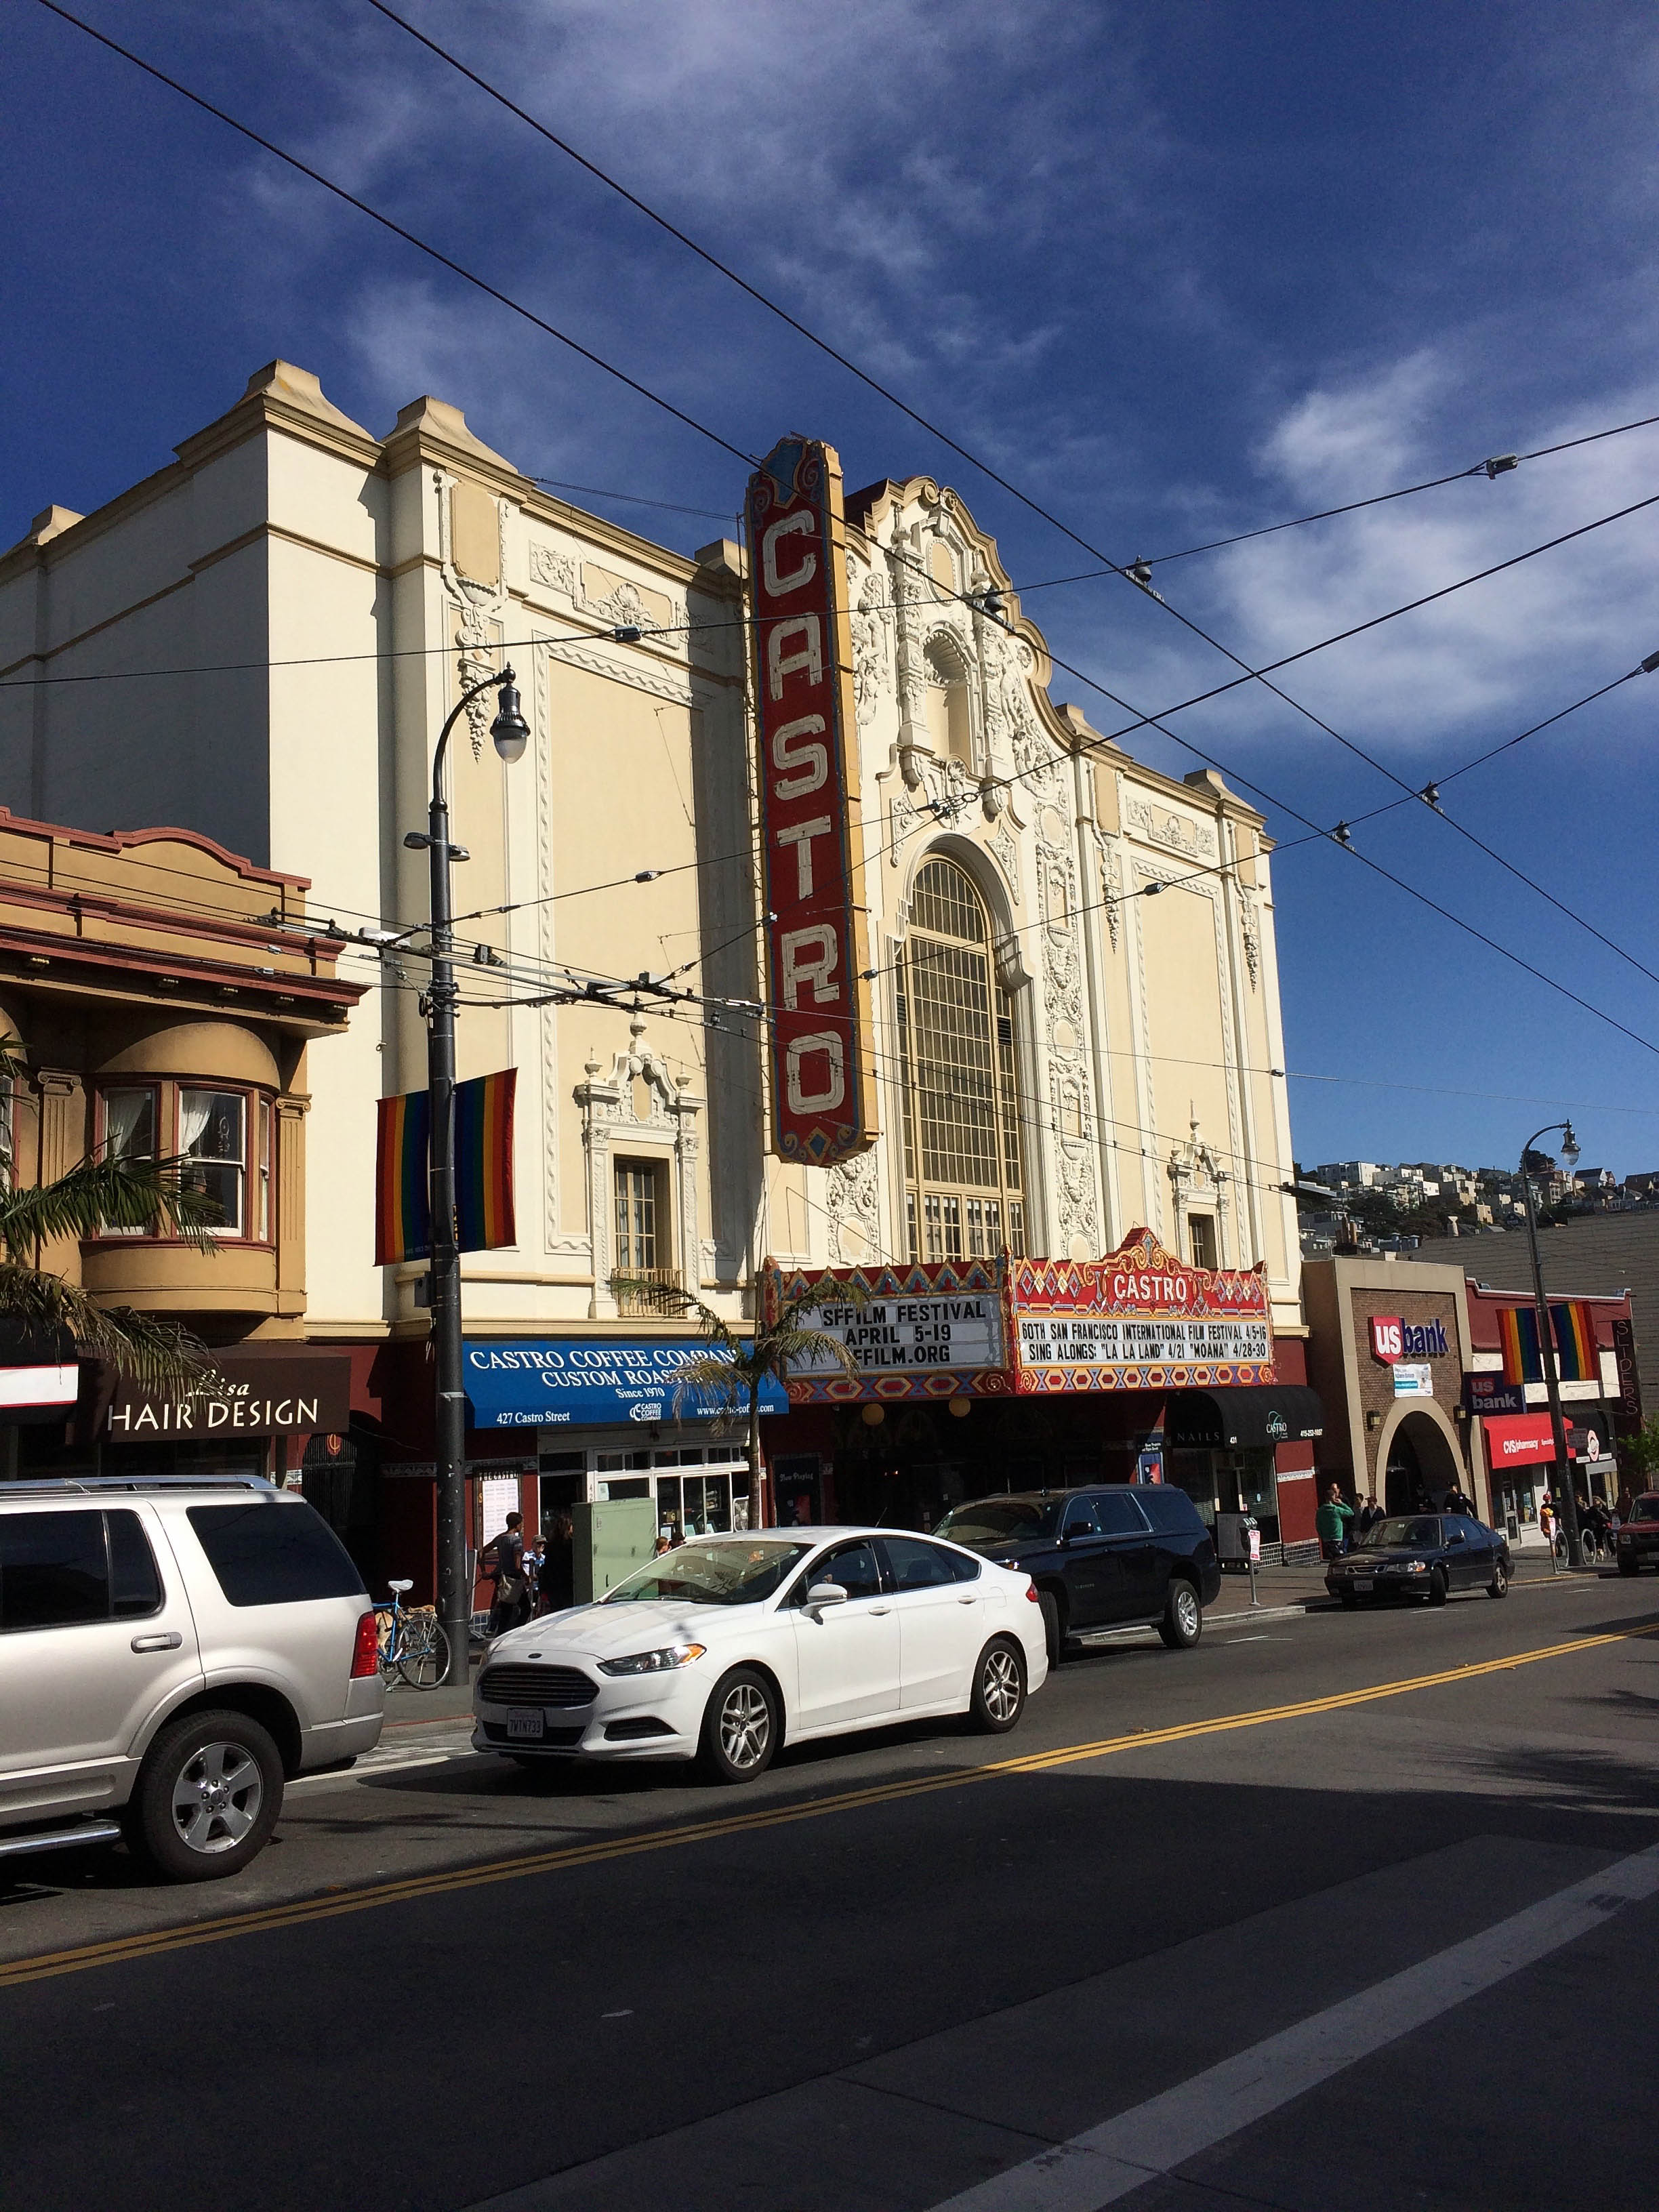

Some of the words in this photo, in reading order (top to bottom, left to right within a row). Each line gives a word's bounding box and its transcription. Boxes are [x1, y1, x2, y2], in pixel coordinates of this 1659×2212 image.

[763, 510, 844, 1115] CASTRO
[1114, 1275, 1187, 1301] CASTRO
[823, 1307, 886, 1326] SFFILM
[897, 1301, 986, 1322] FESTIVAL
[846, 1326, 900, 1345] APRIL
[915, 1324, 951, 1343] 5-19
[1022, 1323, 1046, 1340] 60TH
[1051, 1324, 1068, 1340] SAN
[1072, 1324, 1118, 1340] FRANCISCO
[1122, 1324, 1185, 1340] INTERNATIONAL
[1208, 1326, 1242, 1340] FESTIVAL
[1246, 1326, 1266, 1340] 4/5-16
[1401, 1317, 1450, 1353] bank
[470, 1351, 565, 1369] CASTRO
[569, 1350, 653, 1368] COFFEE
[653, 1349, 737, 1366] COMPAN
[854, 1345, 950, 1366] FFILM.ORG
[1029, 1344, 1052, 1360] SING
[1057, 1344, 1097, 1360] ALONGS:
[1101, 1343, 1118, 1359] "LA
[1123, 1344, 1136, 1359] LA
[1139, 1343, 1164, 1359] LAND"
[1168, 1343, 1185, 1358] 4/21
[1190, 1343, 1228, 1358] "MOANA"
[1233, 1343, 1266, 1357] 4/28-30
[1616, 1322, 1637, 1415] SLIDERS
[541, 1371, 623, 1387] CUSTOM
[1471, 1379, 1494, 1393] us
[615, 1388, 643, 1398] Since
[644, 1387, 665, 1397] 1970
[1472, 1393, 1518, 1410] bank
[108, 1403, 194, 1431] HAIR
[207, 1398, 319, 1429] DESIGN
[497, 1412, 513, 1424] 427
[514, 1412, 544, 1424] Castro
[545, 1411, 570, 1422] Street
[1177, 1432, 1220, 1441] NAILS
[1266, 1422, 1287, 1433] CASTRO
